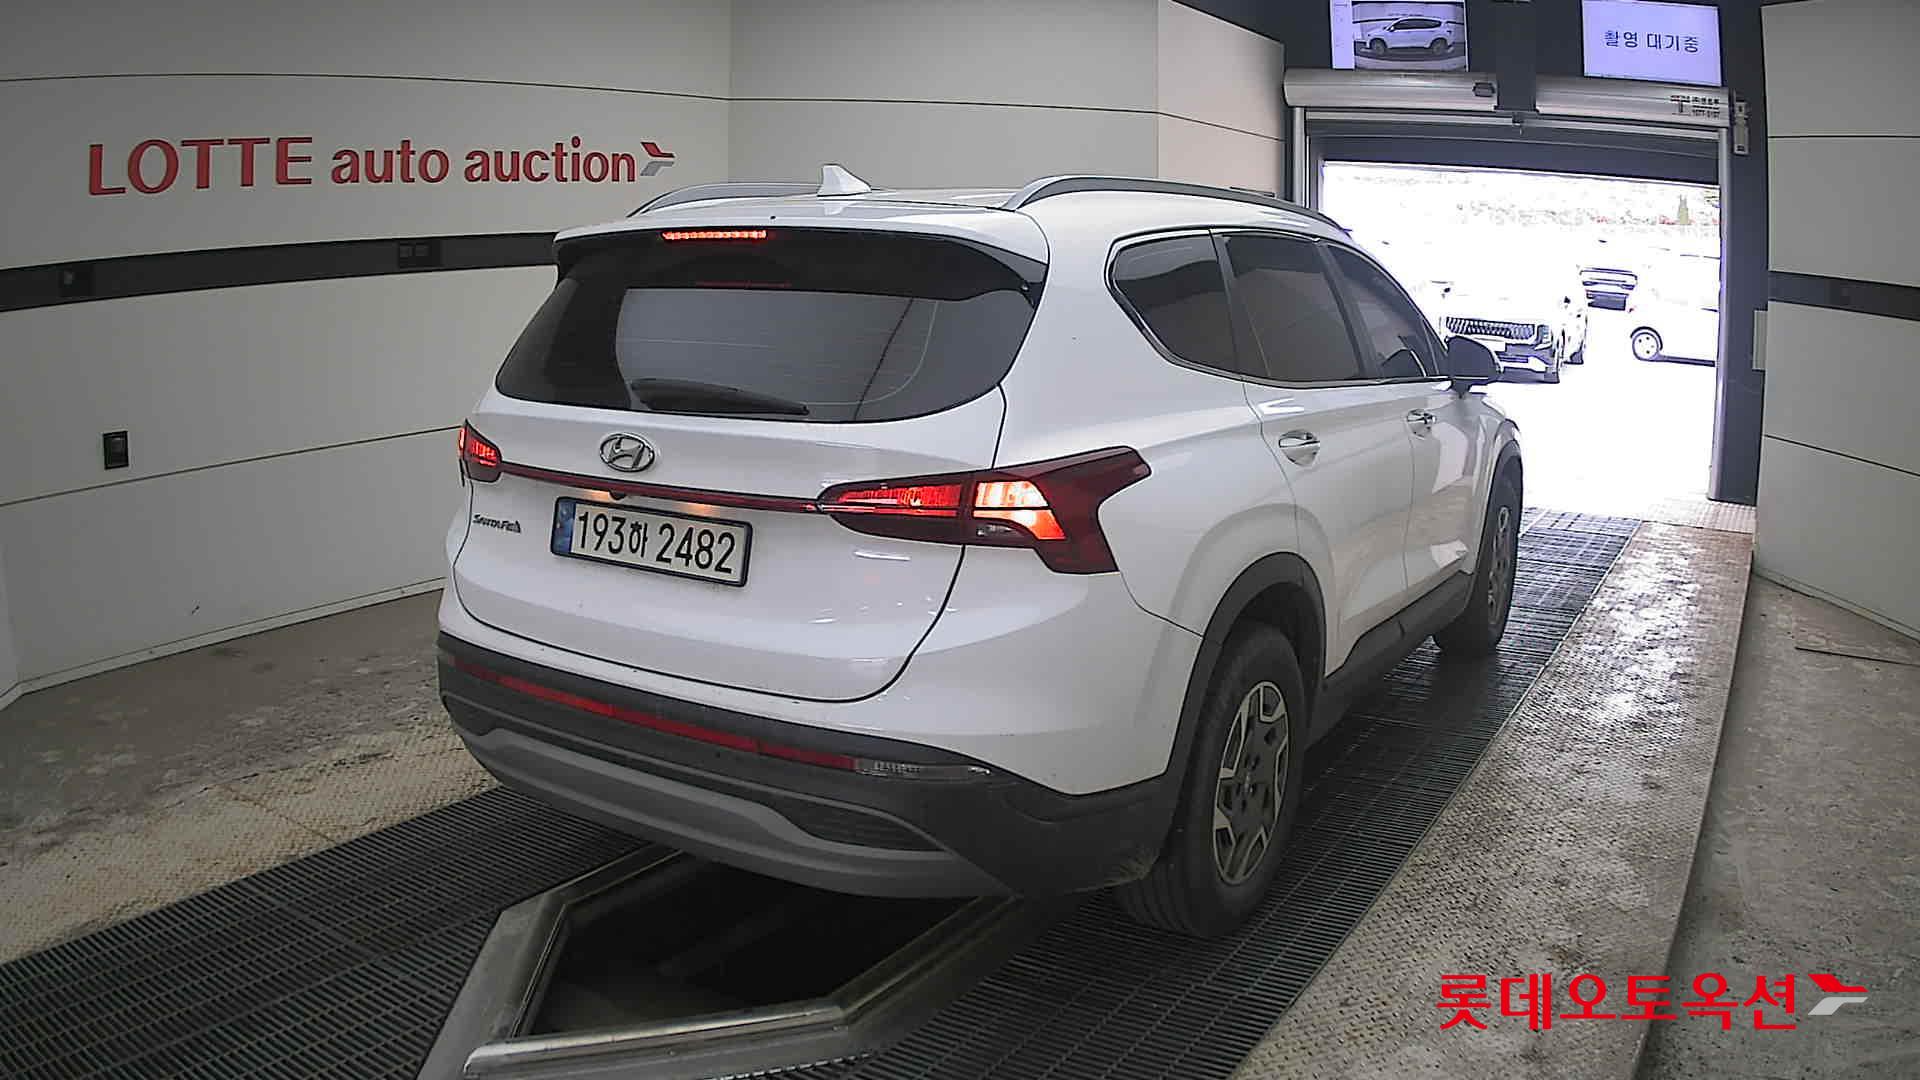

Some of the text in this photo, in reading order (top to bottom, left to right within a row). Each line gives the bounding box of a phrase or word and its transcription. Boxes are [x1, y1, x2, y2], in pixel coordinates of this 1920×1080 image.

[1604, 30, 1699, 53] 촬영 대기중
[88, 136, 636, 196] LOTTE auto auction
[578, 511, 736, 574] 193하 2482
